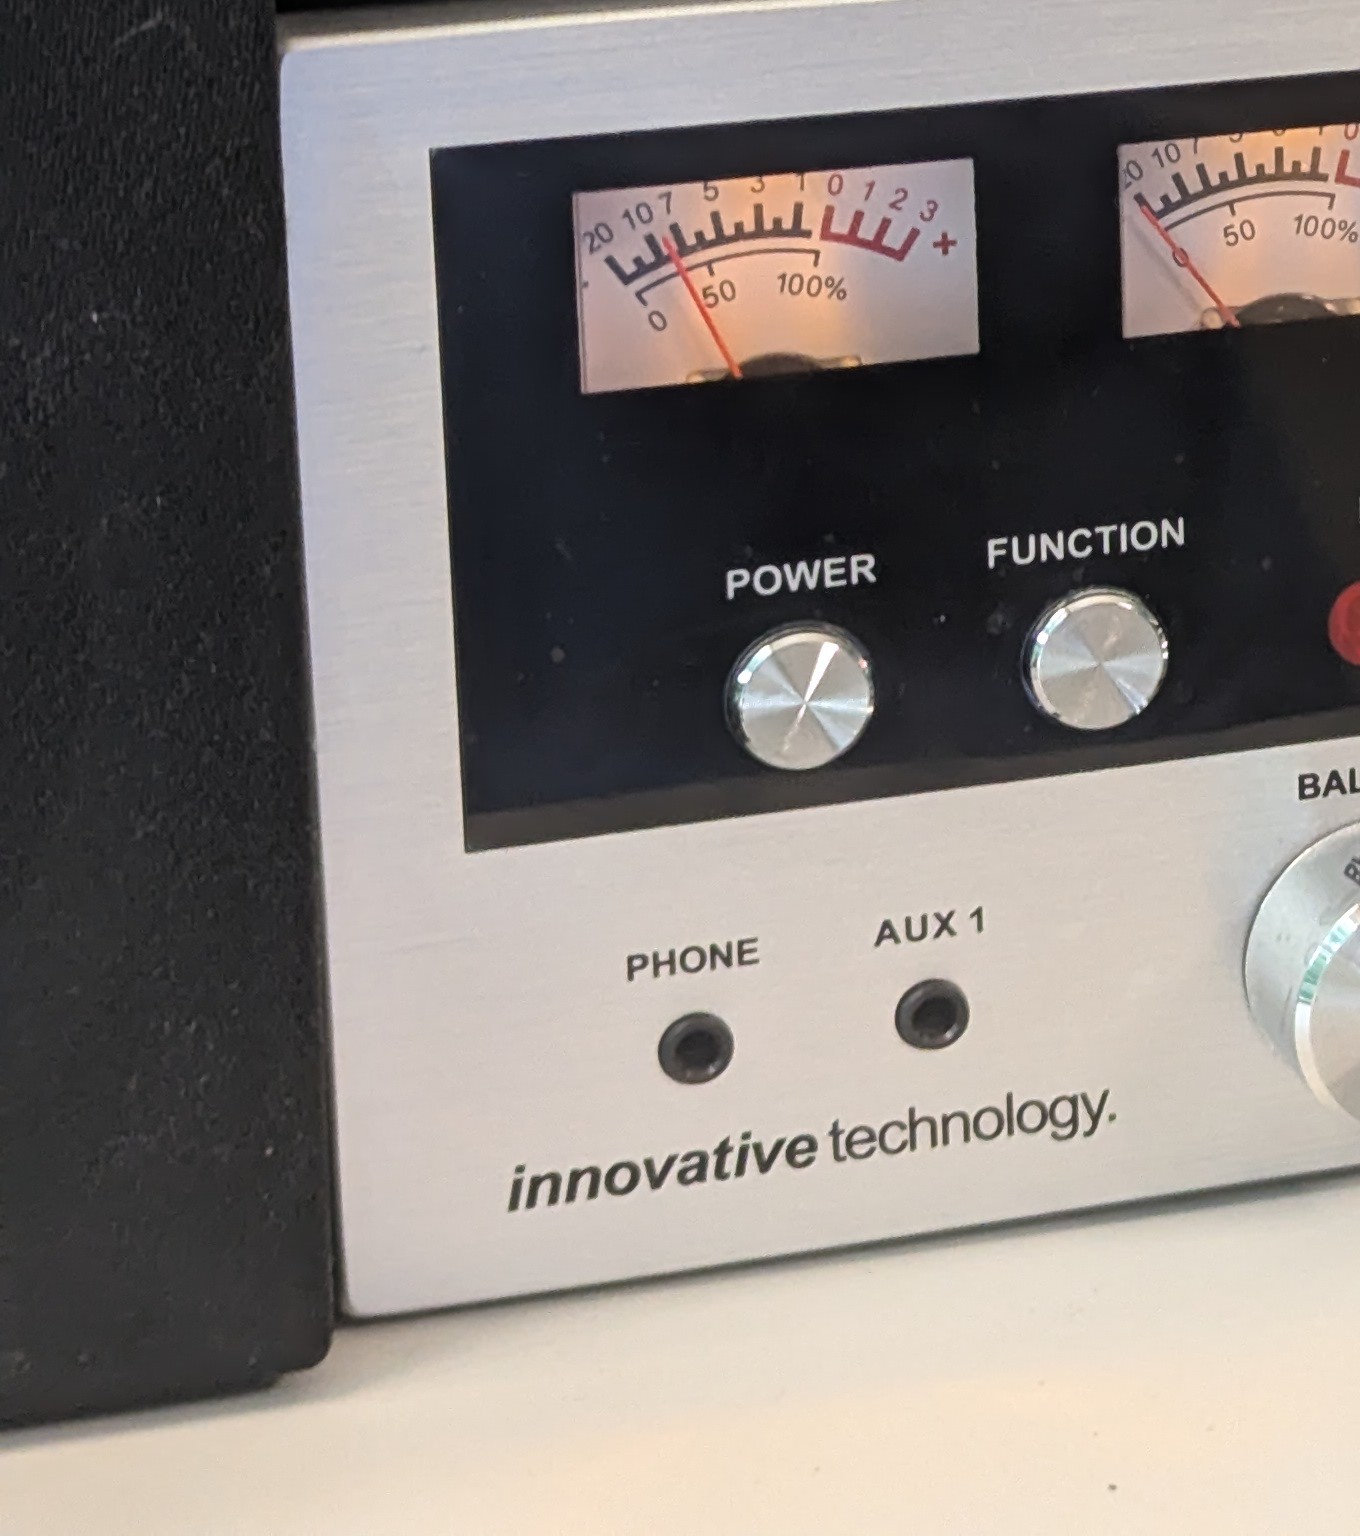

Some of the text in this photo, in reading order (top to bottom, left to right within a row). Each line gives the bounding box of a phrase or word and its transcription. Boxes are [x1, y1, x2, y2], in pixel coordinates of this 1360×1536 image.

[1152, 143, 1181, 168] 10
[583, 222, 614, 255] 20
[622, 201, 654, 230] 10
[658, 191, 674, 215] 7
[888, 188, 908, 211] 2
[919, 199, 939, 222] 3
[1223, 214, 1359, 247] 50 100%
[702, 272, 848, 309] 50 100%
[986, 517, 1186, 568] FUNCTION
[725, 553, 877, 601] POWER
[874, 906, 985, 948] AUX 1
[626, 937, 760, 982] PHONE
[507, 1088, 1118, 1213] innovative technology.
